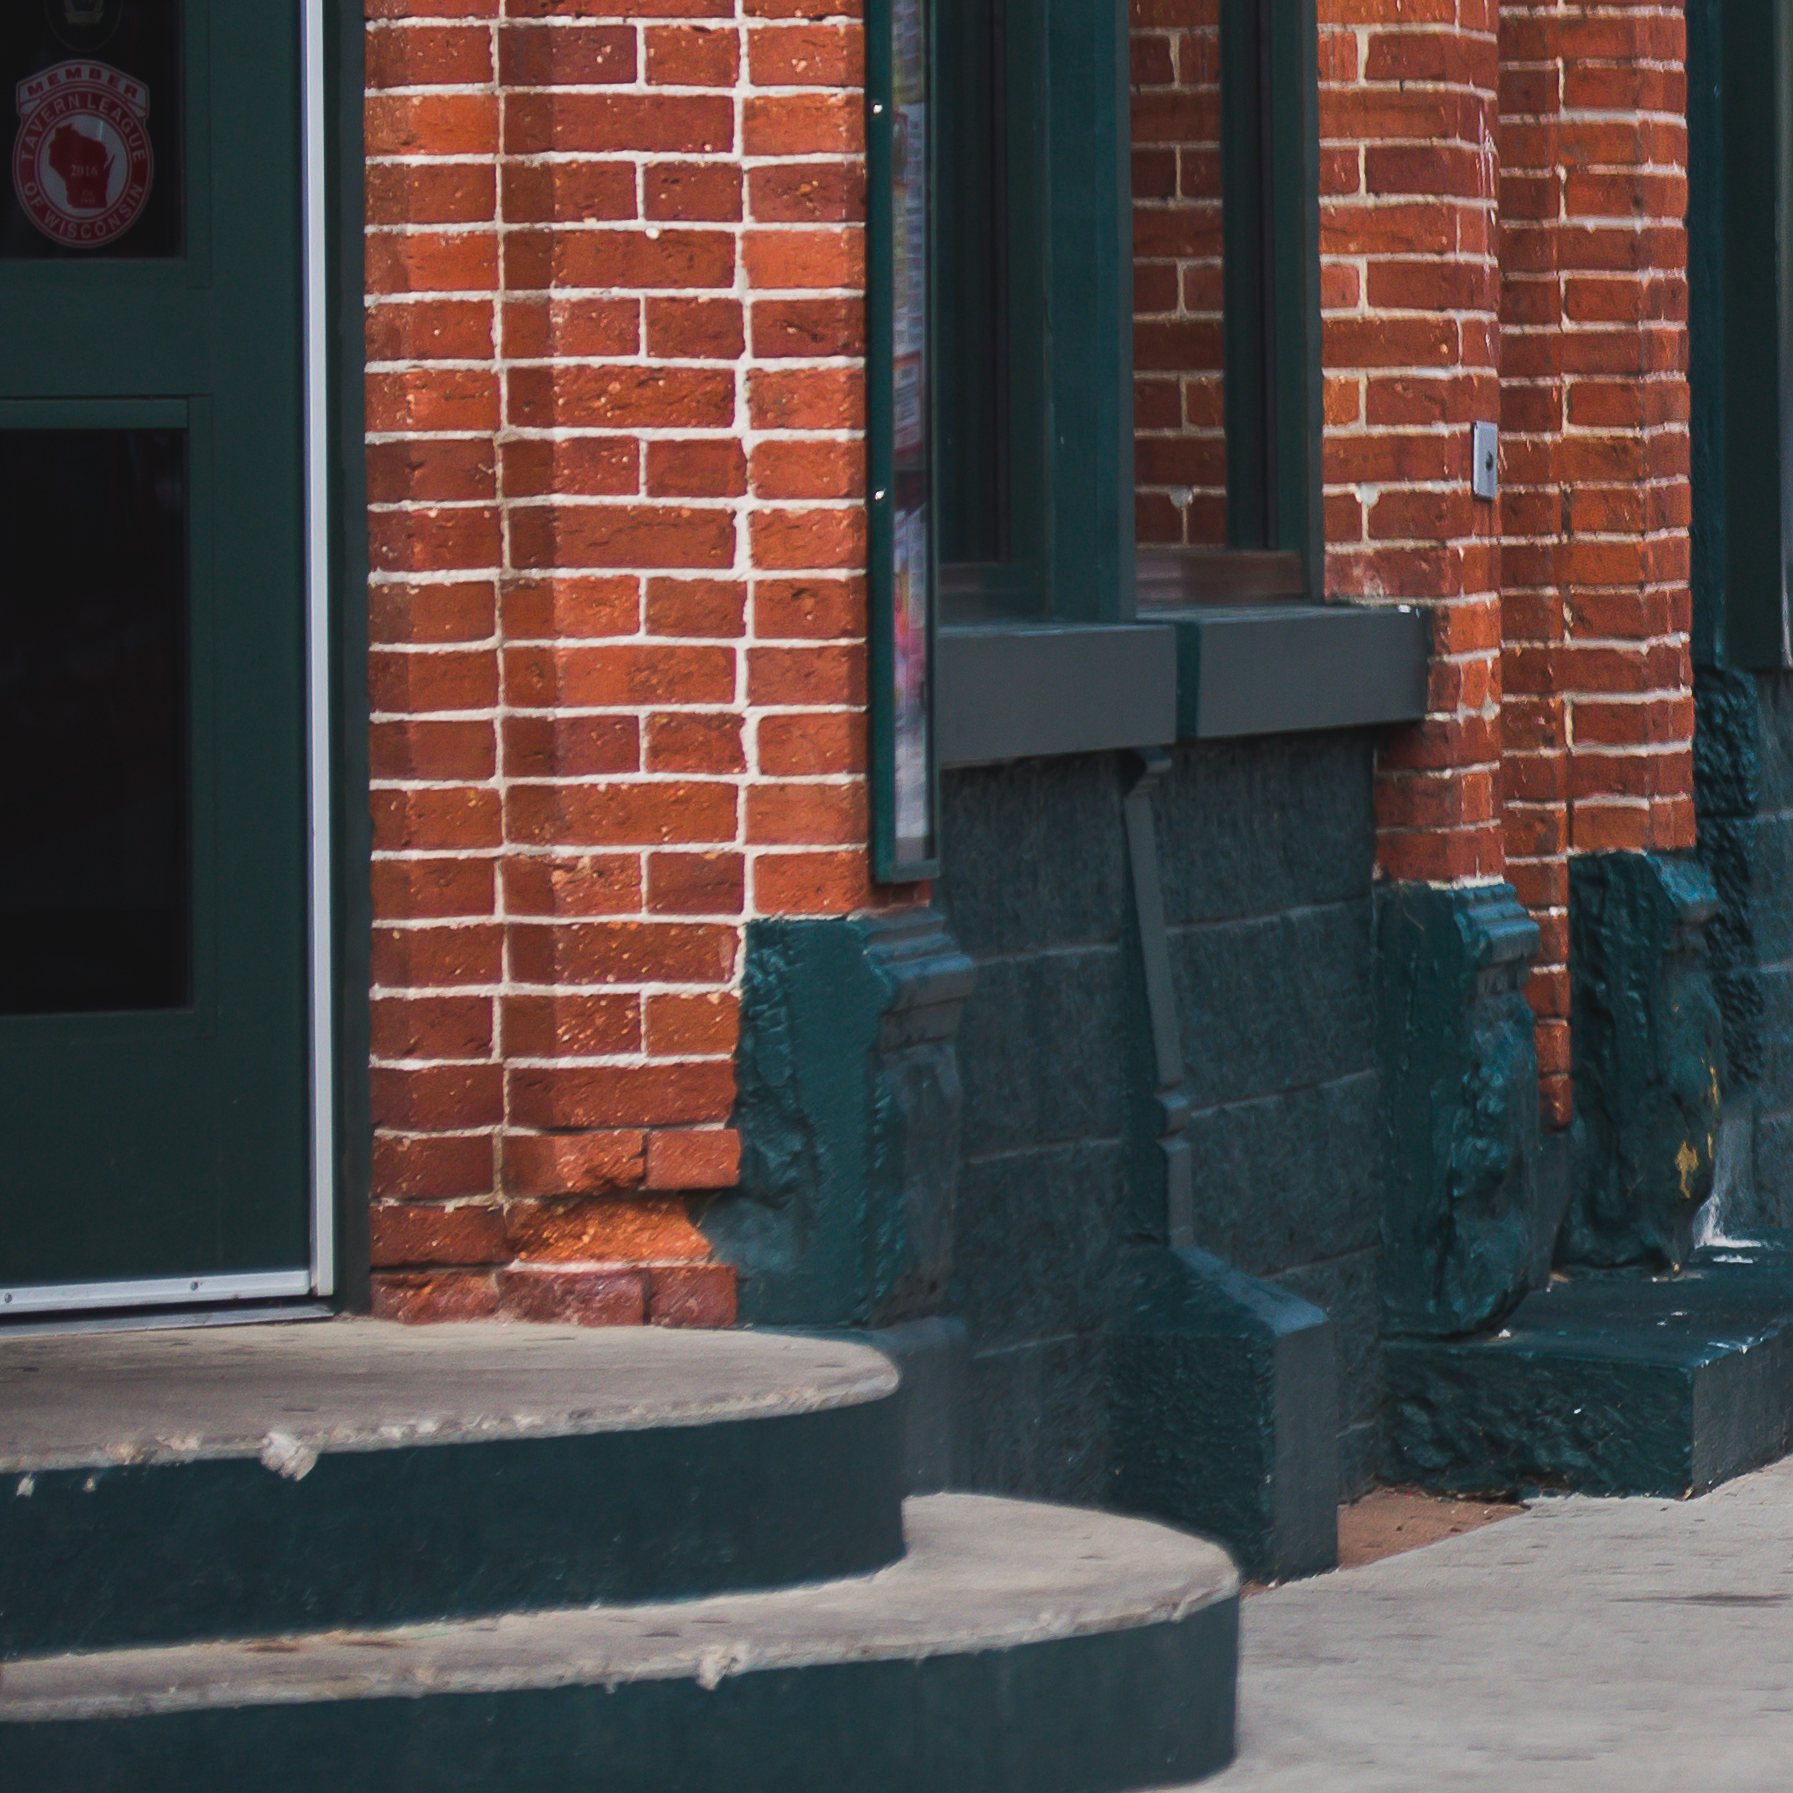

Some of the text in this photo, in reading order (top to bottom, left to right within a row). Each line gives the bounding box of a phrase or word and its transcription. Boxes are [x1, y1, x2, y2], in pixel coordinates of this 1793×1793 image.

[27, 66, 139, 99] MEMBER
[21, 93, 148, 163] TAVERN LEAGUE
[70, 164, 98, 177] 2016
[24, 181, 144, 241] OF WISCONSIN
